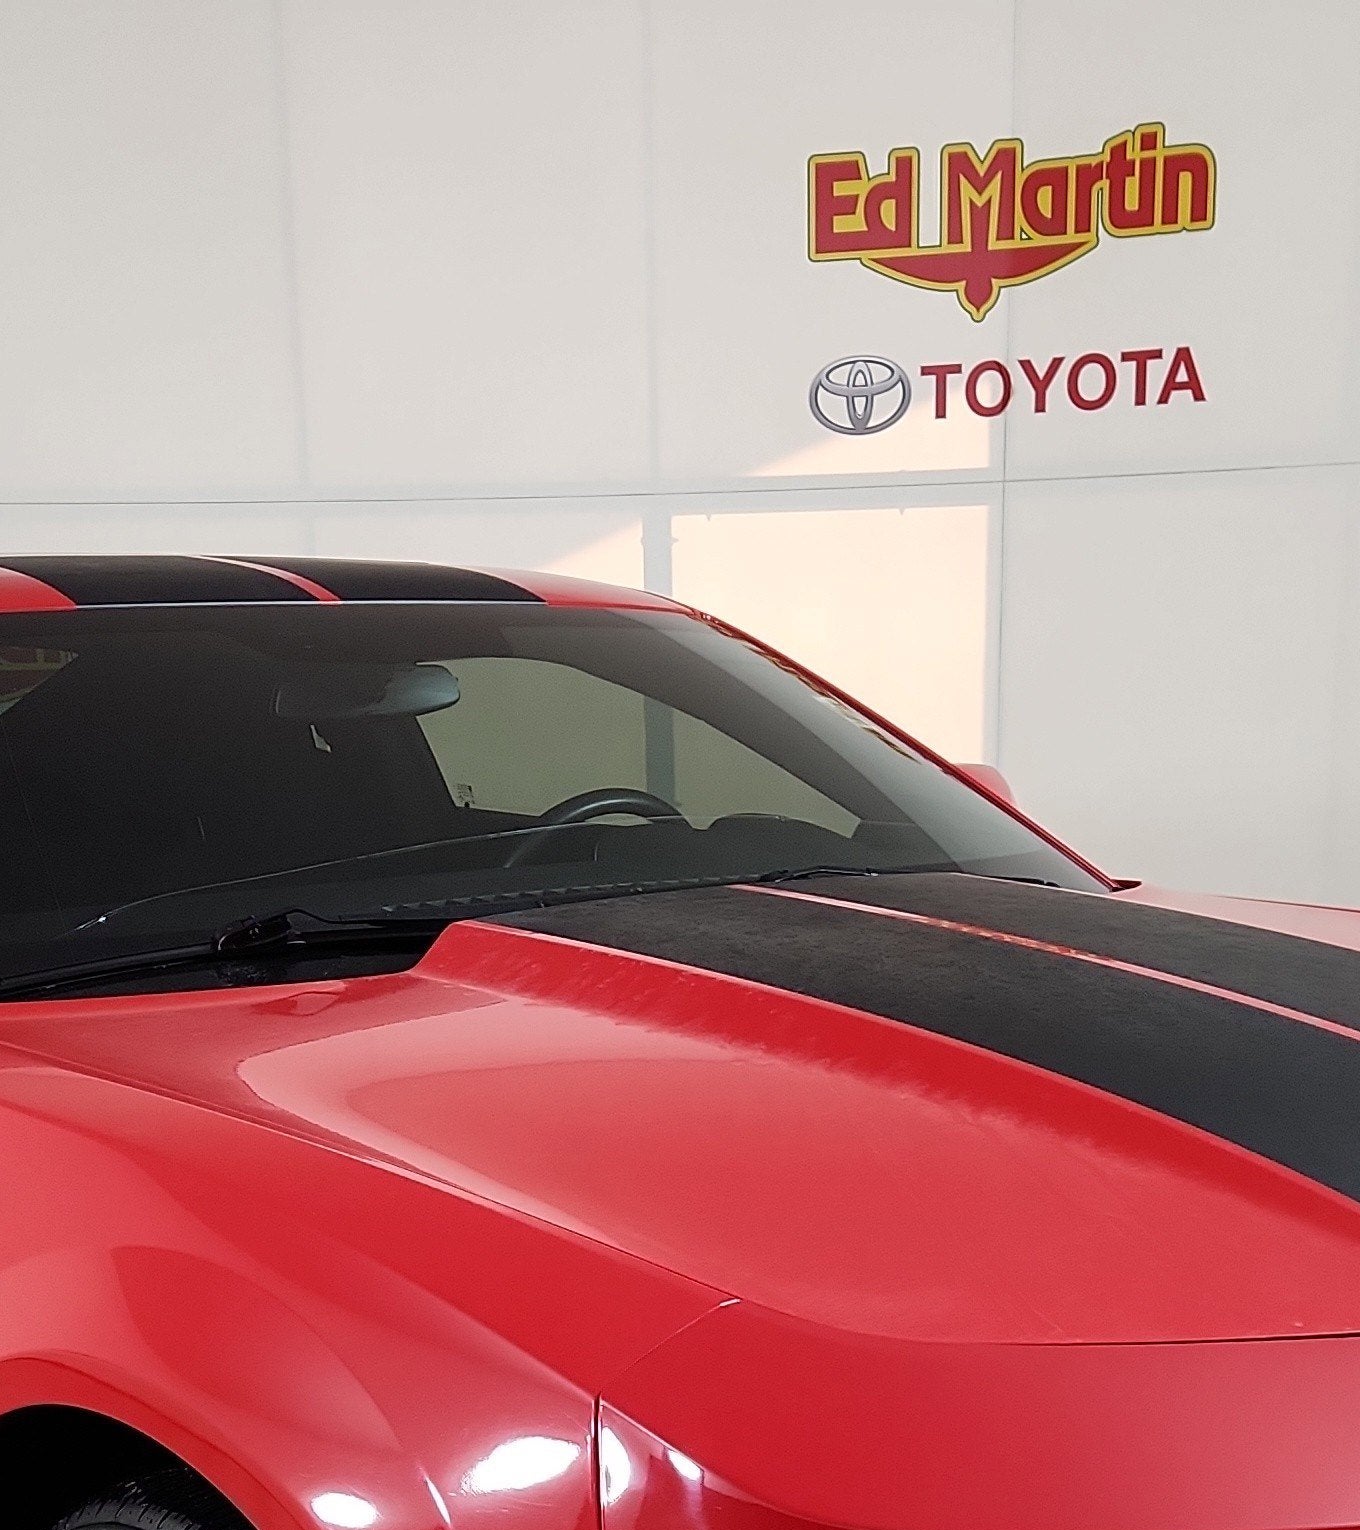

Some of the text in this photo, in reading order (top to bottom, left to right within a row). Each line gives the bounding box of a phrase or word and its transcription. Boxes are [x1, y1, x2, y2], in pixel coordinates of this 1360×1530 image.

[812, 129, 1211, 254] Ed Martin
[921, 347, 1206, 418] TOYOTA
